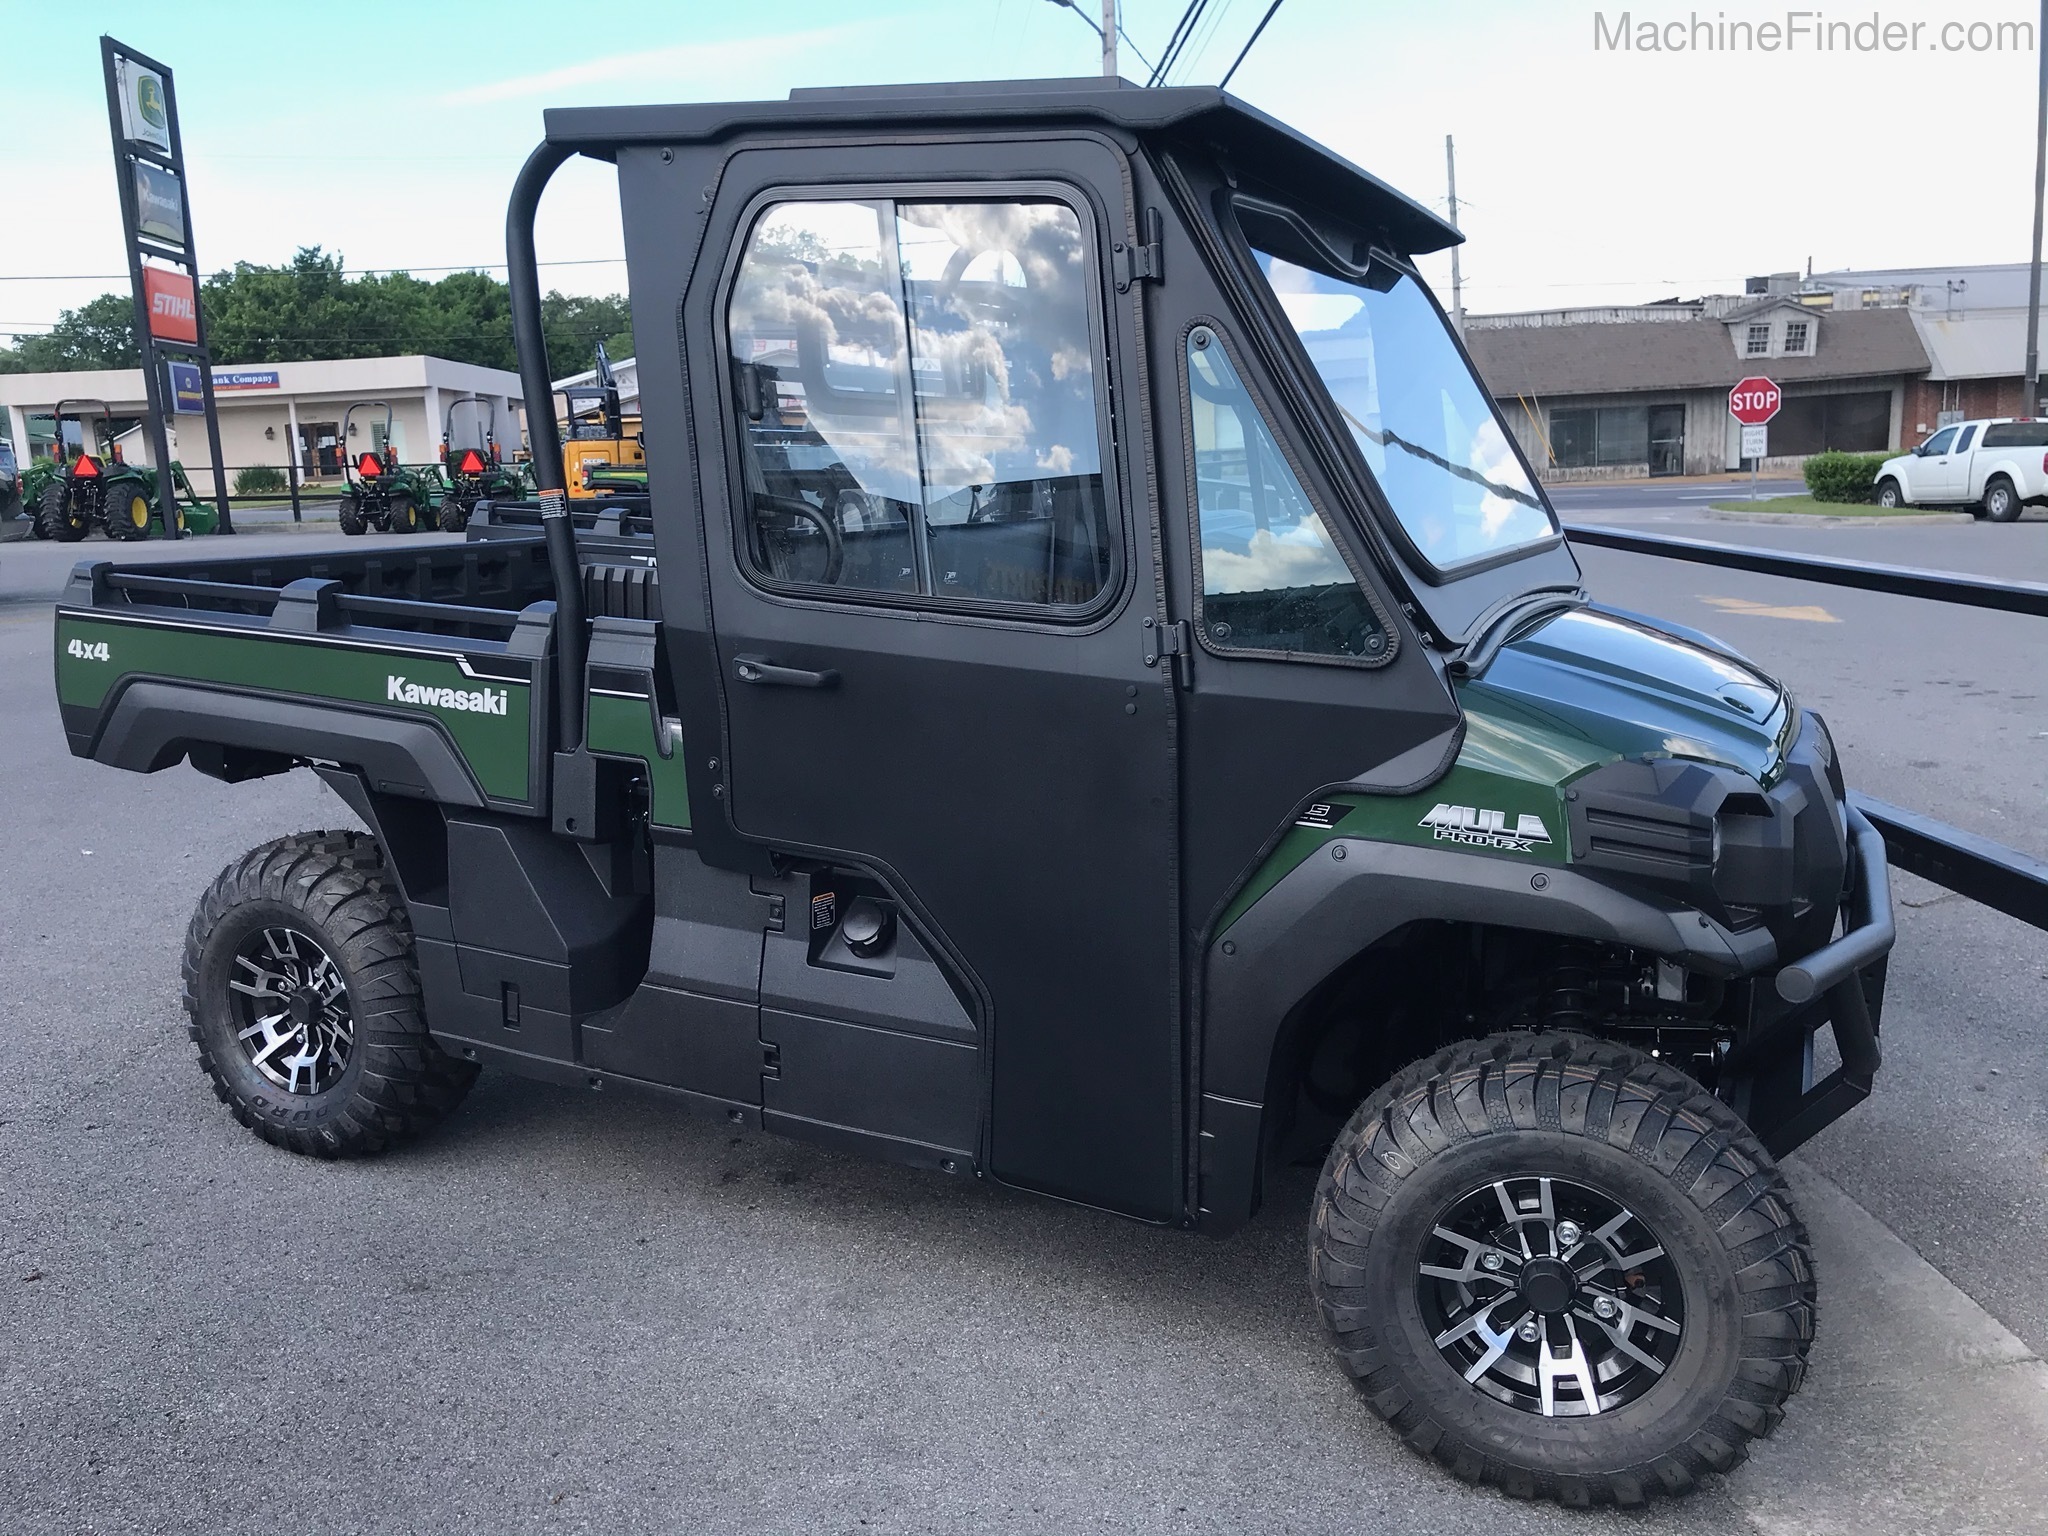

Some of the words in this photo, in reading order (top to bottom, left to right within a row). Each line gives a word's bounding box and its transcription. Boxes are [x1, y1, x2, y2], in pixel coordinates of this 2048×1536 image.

[153, 292, 196, 319] STIHL
[212, 376, 230, 385] ank
[232, 375, 273, 384] Company
[1732, 391, 1777, 411] STOP
[67, 638, 110, 662] 4x4
[387, 675, 507, 716] Kawasaki
[1417, 803, 1552, 844] MULE
